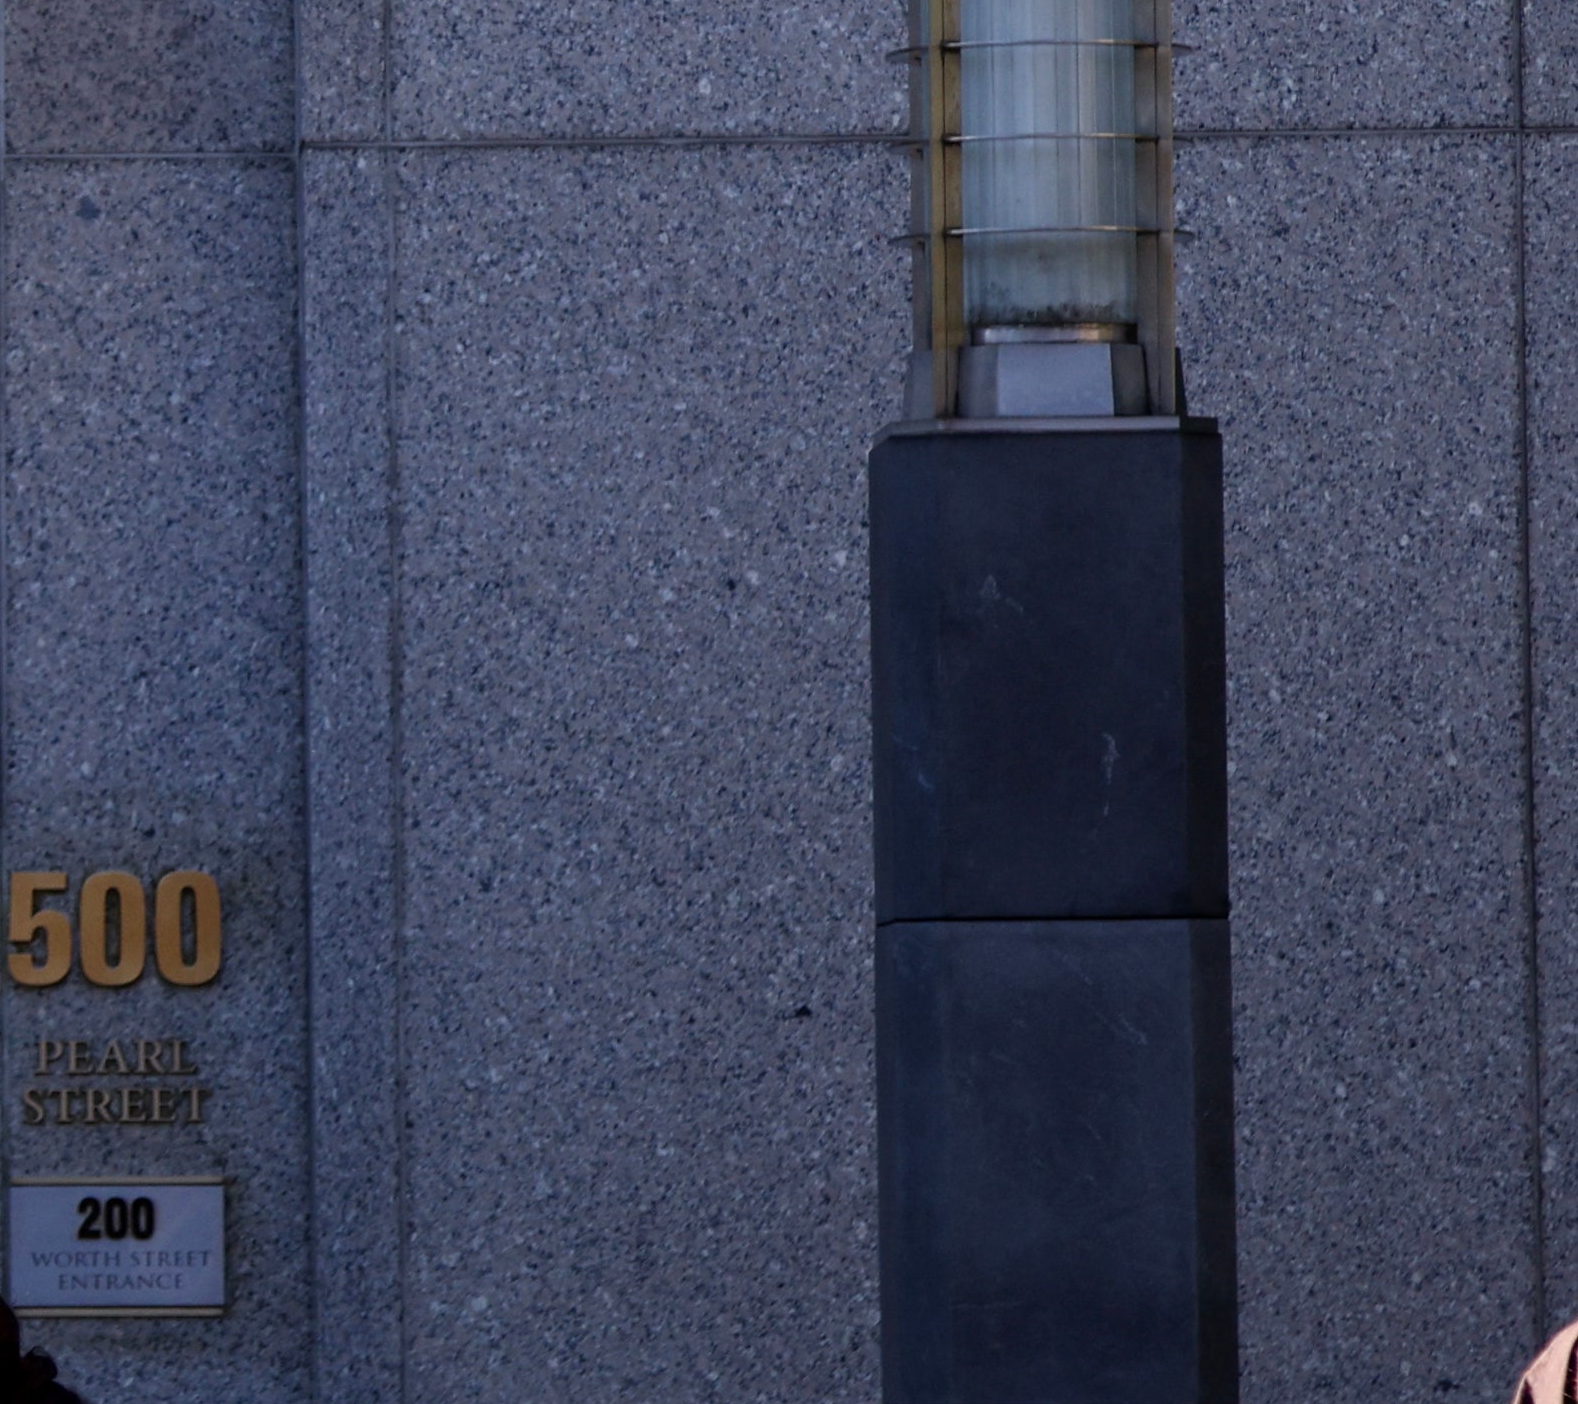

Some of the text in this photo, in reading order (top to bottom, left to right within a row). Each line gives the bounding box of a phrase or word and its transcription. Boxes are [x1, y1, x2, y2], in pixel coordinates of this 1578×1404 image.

[7, 870, 222, 987] 500
[33, 1039, 198, 1075] PEARL
[23, 1086, 212, 1125] STREET
[78, 1196, 155, 1240] 200
[30, 1250, 211, 1268] WORTH STREET
[57, 1272, 184, 1291] ENTRANCE
